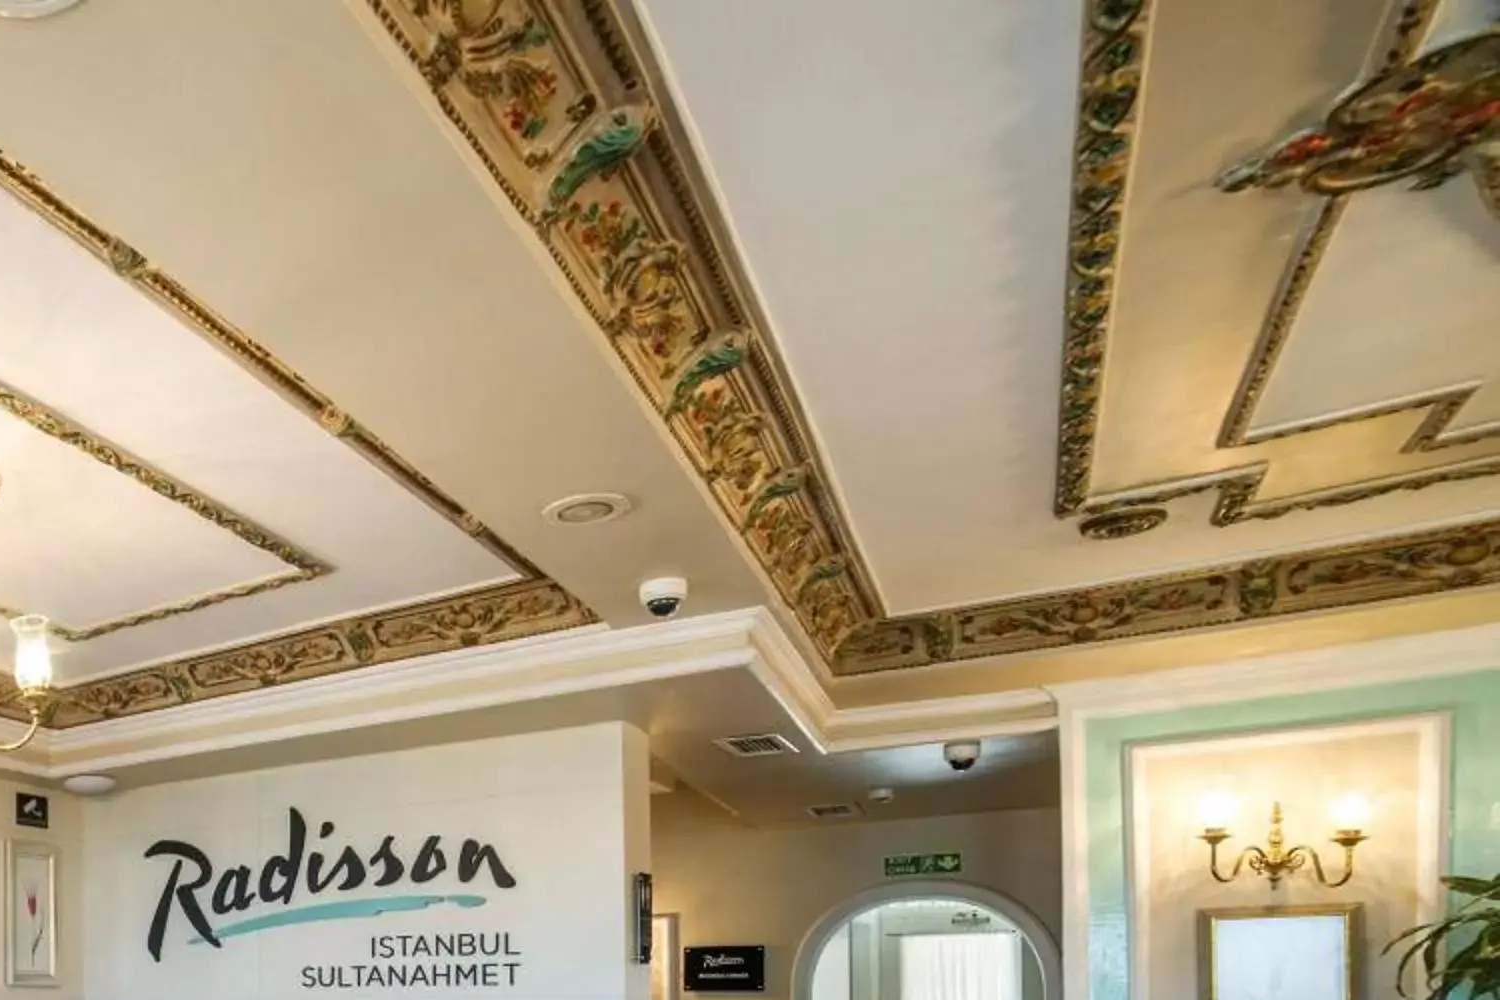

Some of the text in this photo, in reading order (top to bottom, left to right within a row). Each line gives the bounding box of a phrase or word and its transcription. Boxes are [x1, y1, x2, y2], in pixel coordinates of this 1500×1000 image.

[143, 805, 517, 963] Radisson
[370, 932, 522, 959] ISTANBUL
[300, 962, 522, 988] SULTANAHMET
